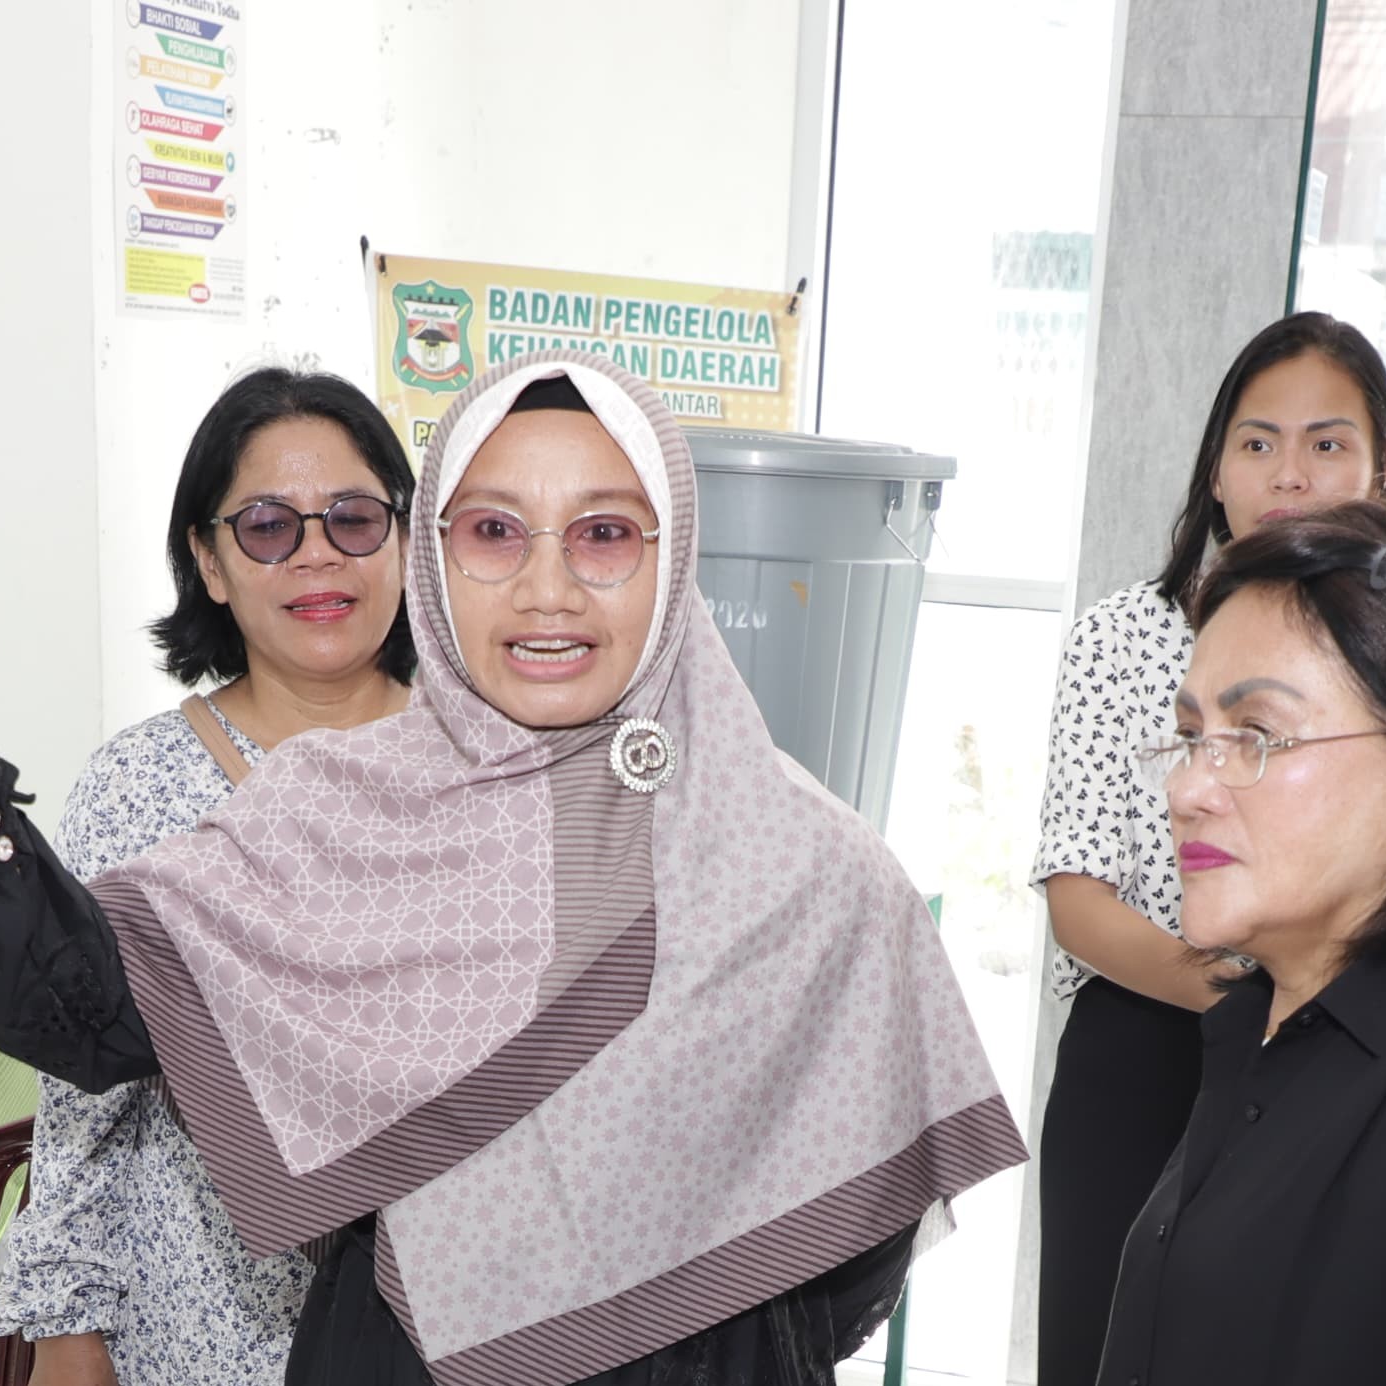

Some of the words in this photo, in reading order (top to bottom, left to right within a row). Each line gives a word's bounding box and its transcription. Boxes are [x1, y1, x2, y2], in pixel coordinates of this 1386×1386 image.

[145, 8, 174, 29] BHAKTI
[141, 112, 180, 131] OLAHRAGA
[180, 120, 204, 136] SEHAT
[488, 288, 592, 329] BADAN
[603, 299, 772, 345] PENGELOLA
[660, 348, 777, 388] DAERAH
[660, 391, 719, 416] ANTAR
